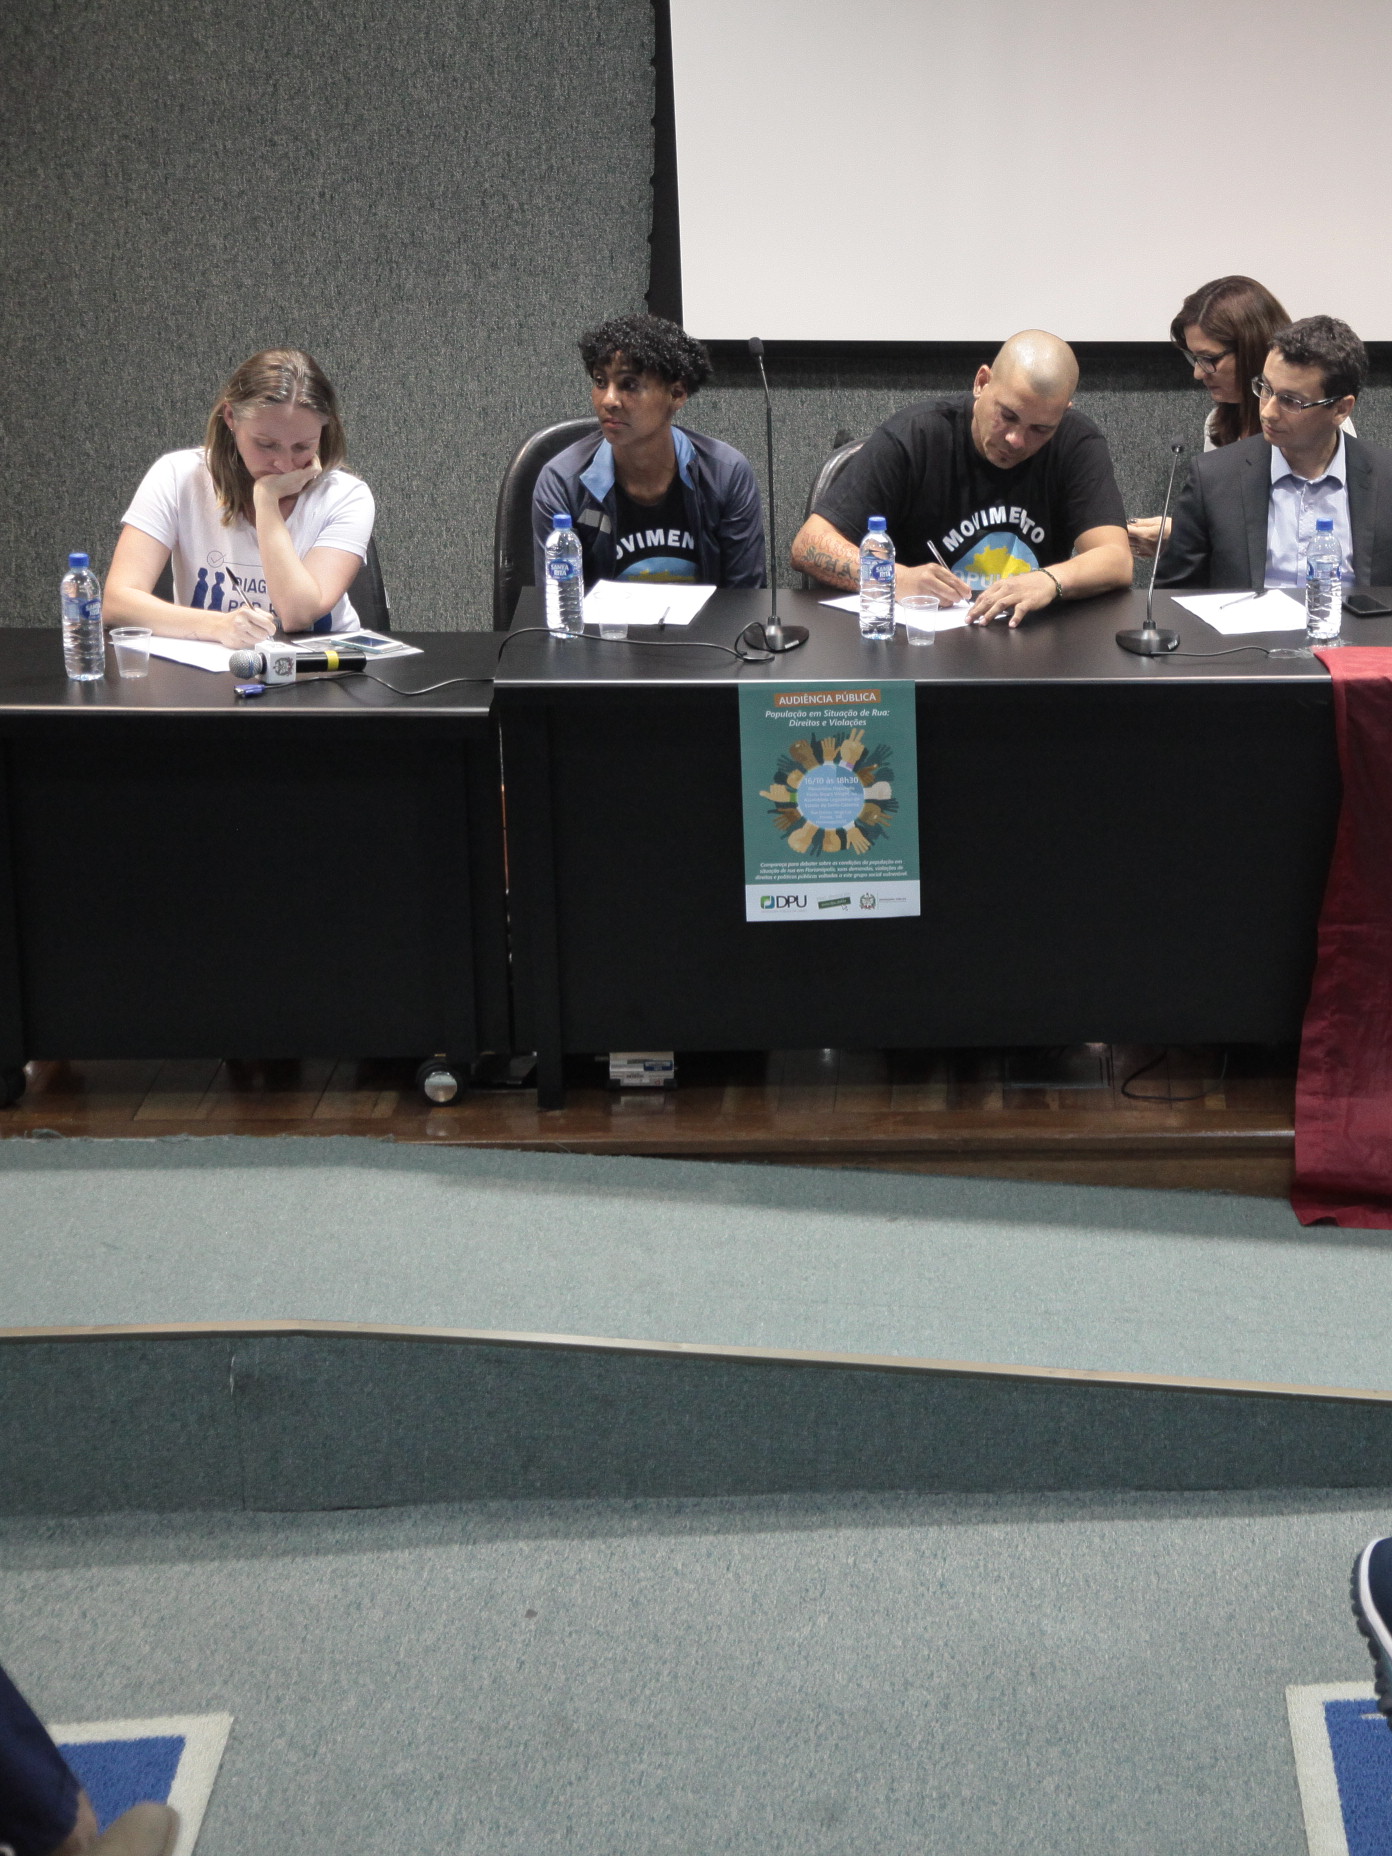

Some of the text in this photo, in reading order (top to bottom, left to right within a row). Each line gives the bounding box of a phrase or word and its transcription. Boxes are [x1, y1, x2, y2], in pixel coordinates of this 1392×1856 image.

[779, 692, 876, 705] AUDIÊNCIA PÚBLICA
[765, 710, 807, 720] População
[824, 710, 857, 718] Situação
[789, 719, 820, 727] Direitos
[829, 719, 866, 727] Violações
[776, 895, 807, 909] DPU
